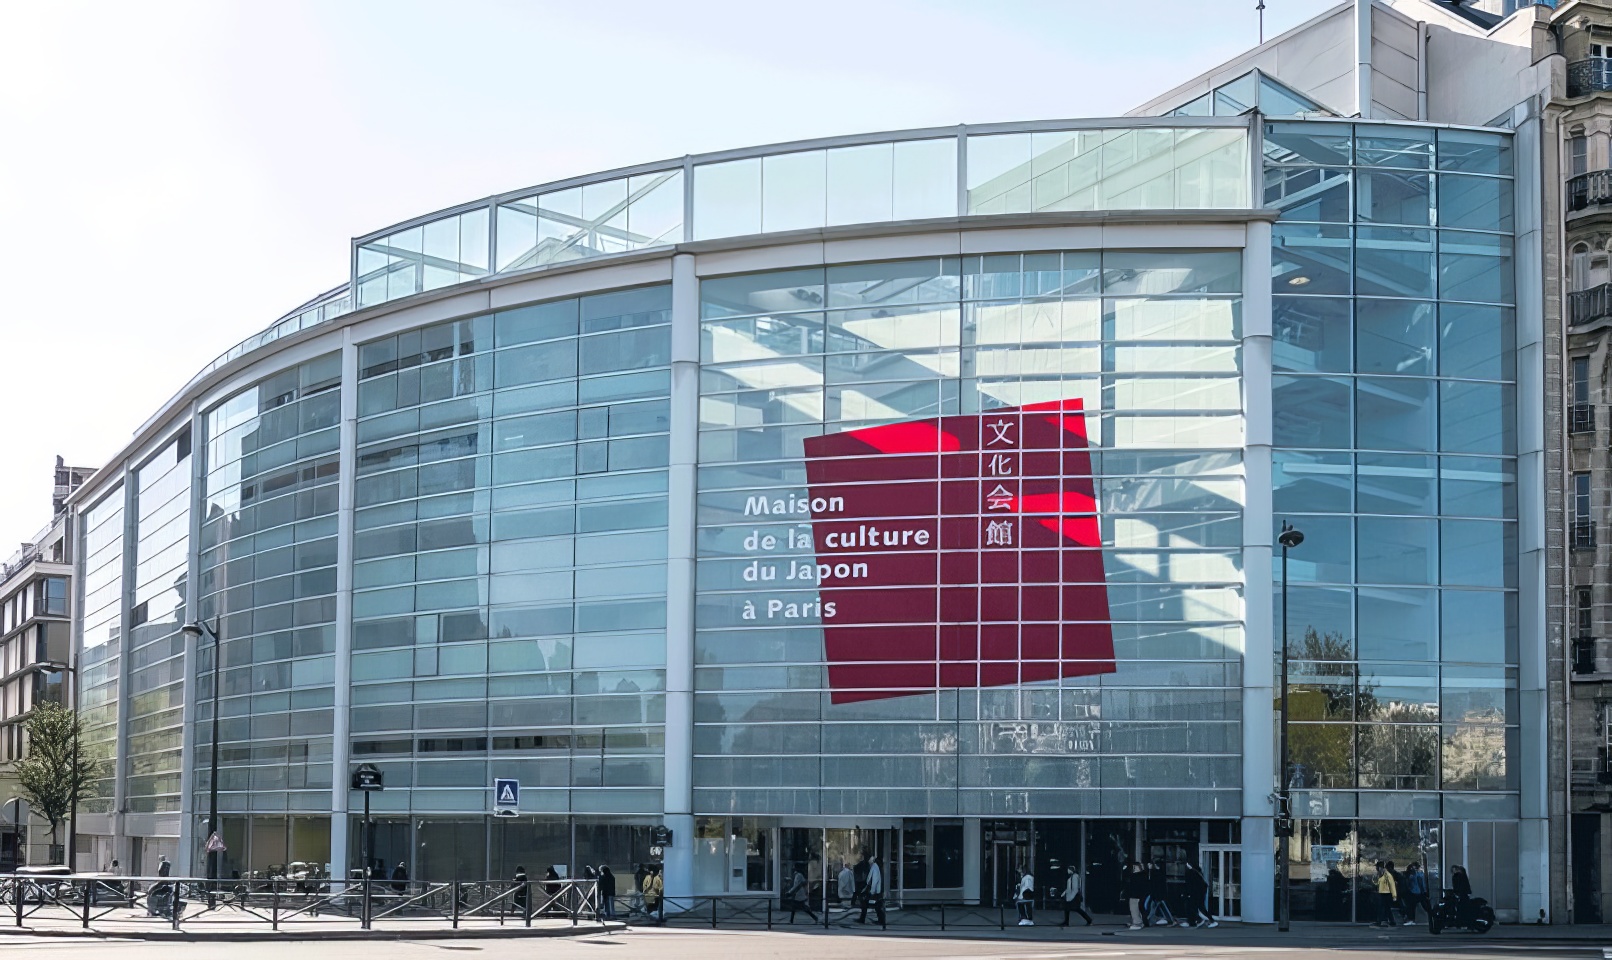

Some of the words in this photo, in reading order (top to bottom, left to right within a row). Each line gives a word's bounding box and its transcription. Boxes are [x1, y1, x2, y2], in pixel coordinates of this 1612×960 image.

[986, 418, 1014, 546] 文化会館
[744, 494, 844, 516] Maison
[743, 530, 776, 551] de
[788, 528, 811, 549] la
[825, 525, 930, 548] culture
[743, 561, 776, 582] du
[786, 559, 868, 586] Japon
[742, 600, 757, 620] à
[768, 597, 837, 618] Paris
